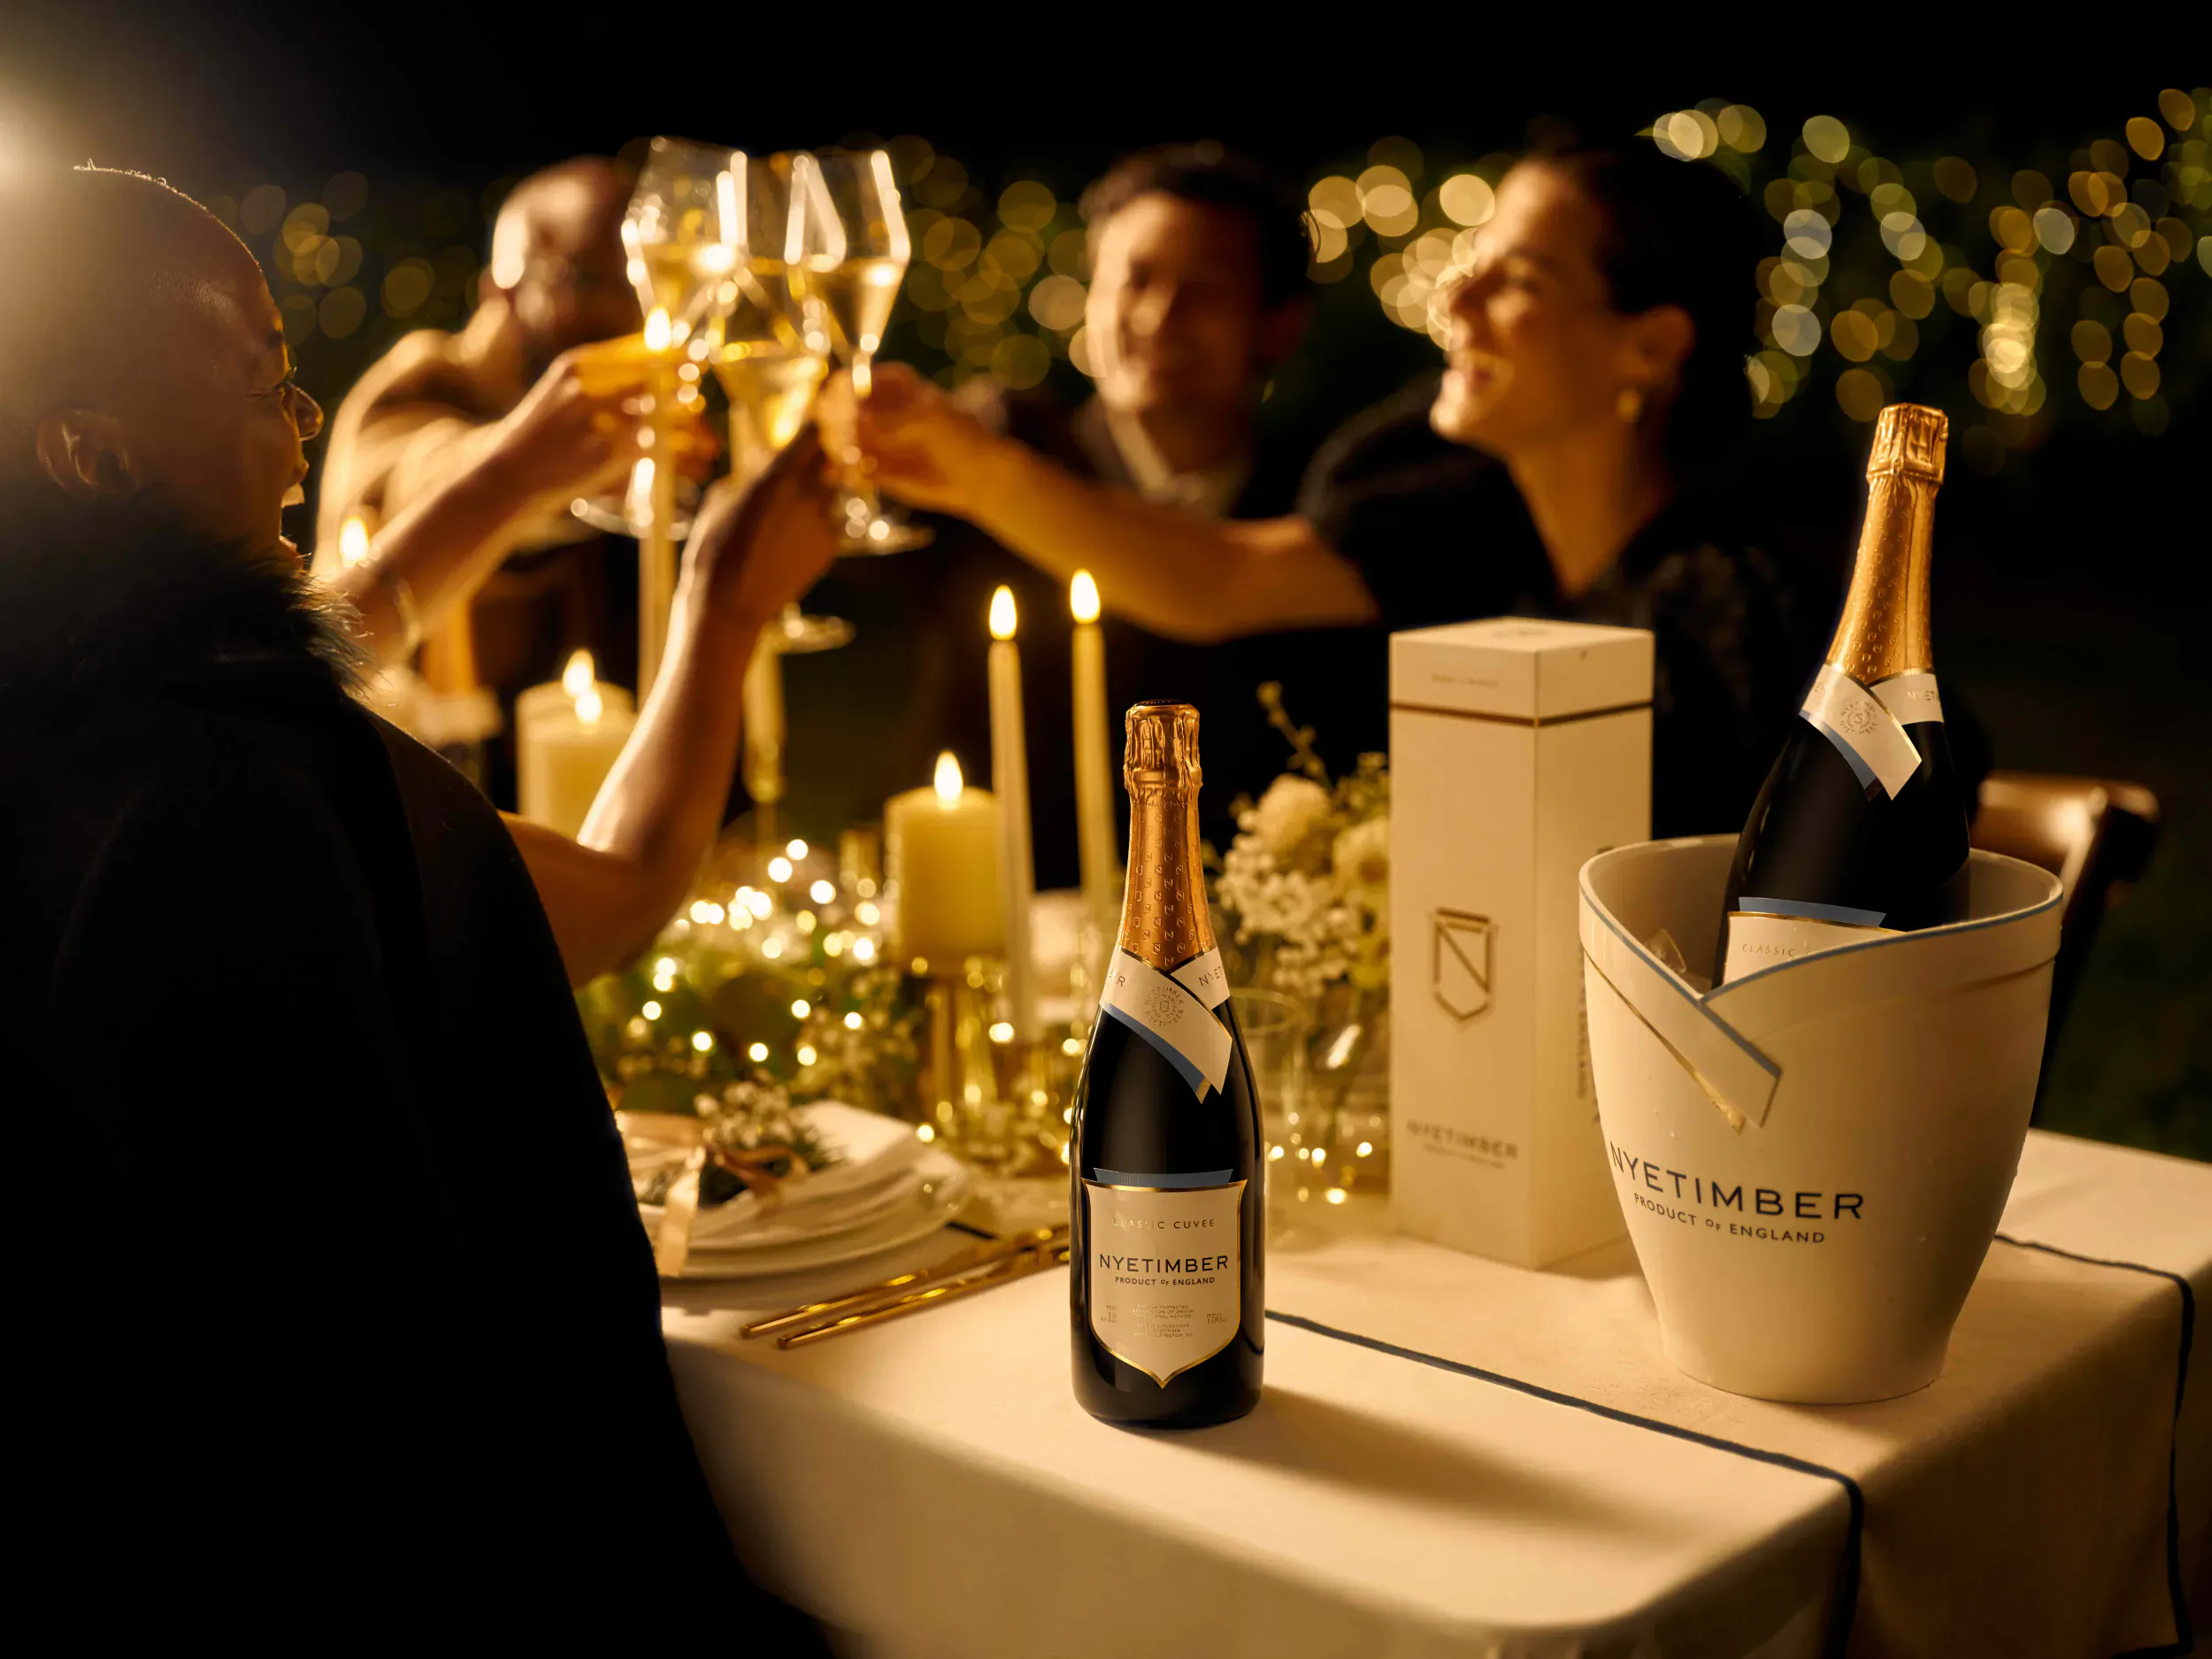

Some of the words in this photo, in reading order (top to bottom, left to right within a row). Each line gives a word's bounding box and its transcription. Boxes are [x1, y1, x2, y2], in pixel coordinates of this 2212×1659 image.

[1741, 943, 1795, 957] CLASSIC
[1609, 1140, 1864, 1220] NYETIMBER
[1111, 1218, 1165, 1229] CLASSIC
[1173, 1218, 1215, 1229] CUVEE
[1633, 1192, 1697, 1226] PRODUCT
[1730, 1224, 1825, 1243] ENGLAND
[1100, 1253, 1228, 1273] NYETIMBER
[1115, 1276, 1156, 1286] PRODUCT
[1172, 1277, 1215, 1286] ENGLAND
